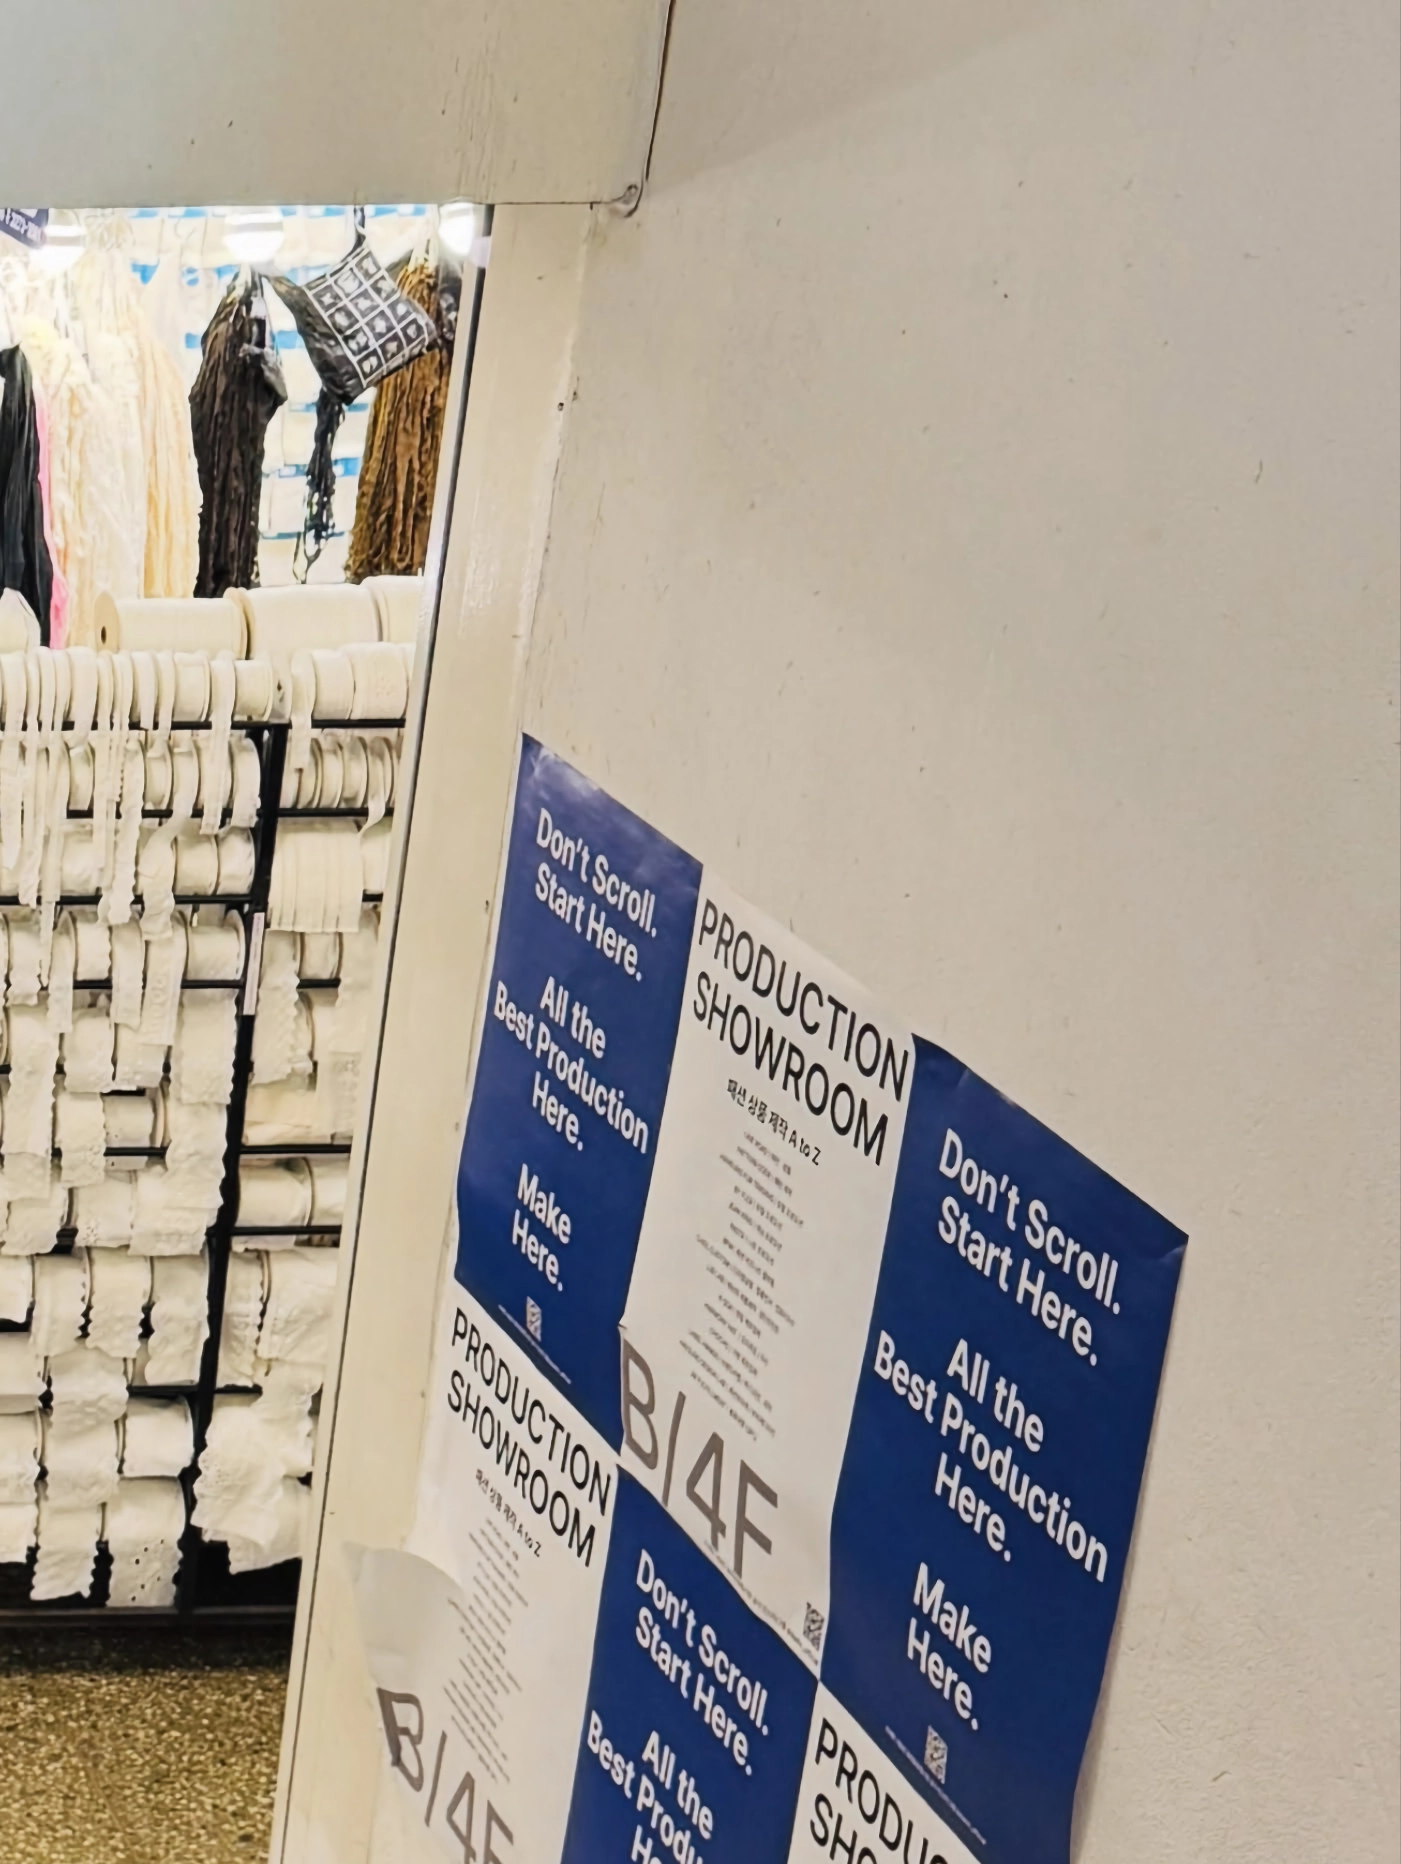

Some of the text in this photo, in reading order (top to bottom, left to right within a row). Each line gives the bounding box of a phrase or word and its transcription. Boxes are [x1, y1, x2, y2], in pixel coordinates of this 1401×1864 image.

[535, 863, 642, 982] Start Here.
[536, 807, 657, 938] Don't Scroll.
[540, 976, 606, 1059] All the
[698, 898, 909, 1102] PRODUCTION
[494, 980, 649, 1154] Best Production
[532, 1071, 583, 1151] Here.
[694, 971, 889, 1166] SHOWROOM
[517, 1163, 572, 1244] Make
[788, 1129, 797, 1148] A
[811, 1146, 821, 1166] Z
[512, 1209, 563, 1291] Here.
[938, 1127, 1120, 1315] Don't Scroll.
[938, 1196, 1097, 1366] Start Here.
[452, 1307, 611, 1516] PRODUCTION
[946, 1338, 1044, 1452] All the
[448, 1369, 595, 1568] SHOWROOM
[874, 1329, 1108, 1583] Best Production
[934, 1452, 1011, 1562] Here.
[636, 1548, 696, 1648] Don't
[699, 1624, 768, 1736] Scroll.
[907, 1617, 978, 1731] Here.
[913, 1562, 991, 1673] Make
[635, 1606, 752, 1776] Start Here.
[587, 1709, 635, 1799] Best
[642, 1730, 714, 1840] All the
